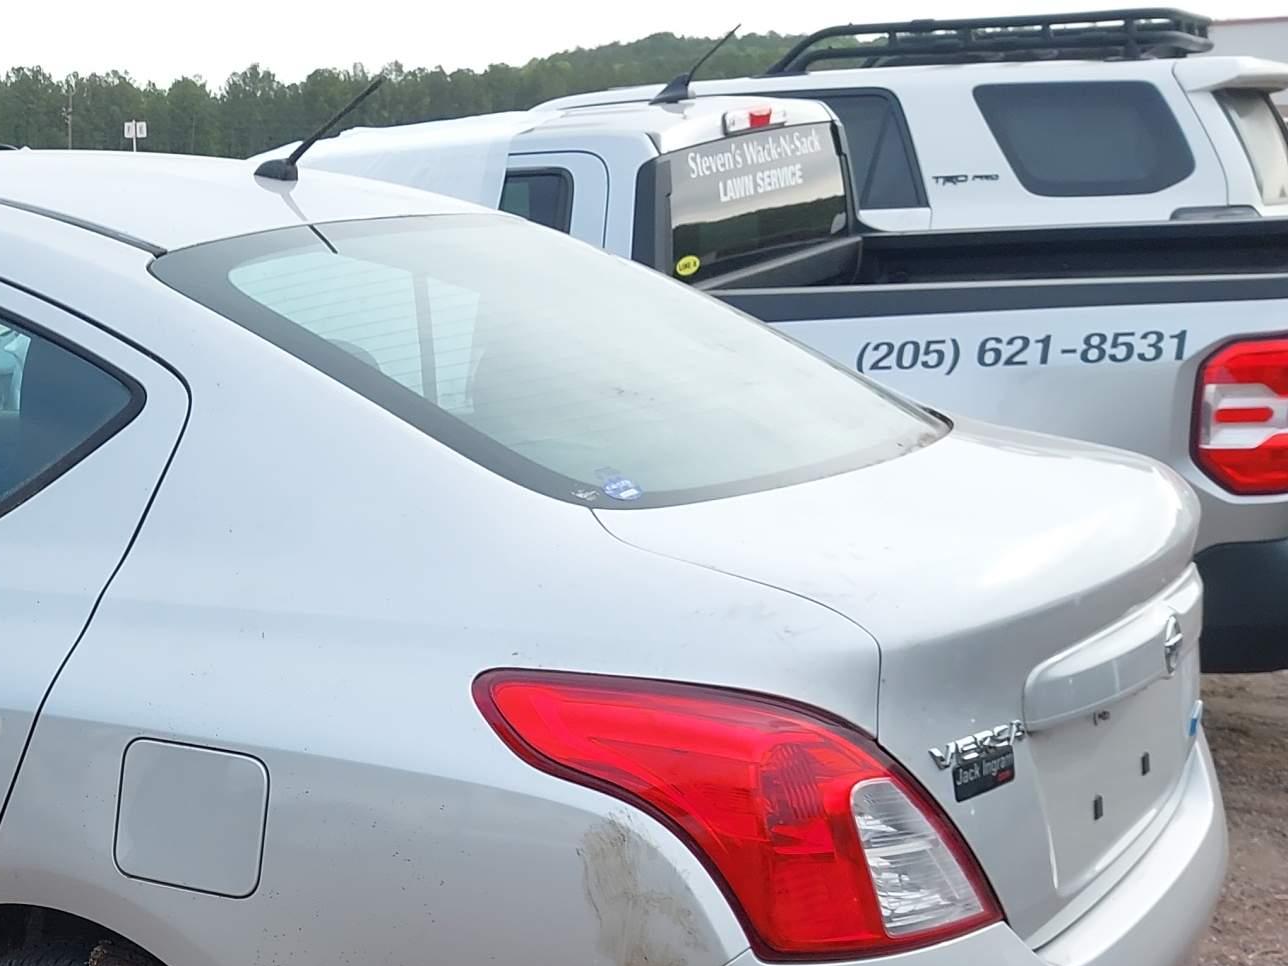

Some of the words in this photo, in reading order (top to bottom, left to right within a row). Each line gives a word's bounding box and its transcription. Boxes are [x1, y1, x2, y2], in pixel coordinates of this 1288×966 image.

[687, 143, 743, 178] Steven's
[719, 174, 754, 202] LAWN
[756, 163, 804, 194] SERVICE
[856, 338, 961, 375] (205)
[976, 329, 1188, 367] 621-8531
[955, 763, 981, 786] Jack
